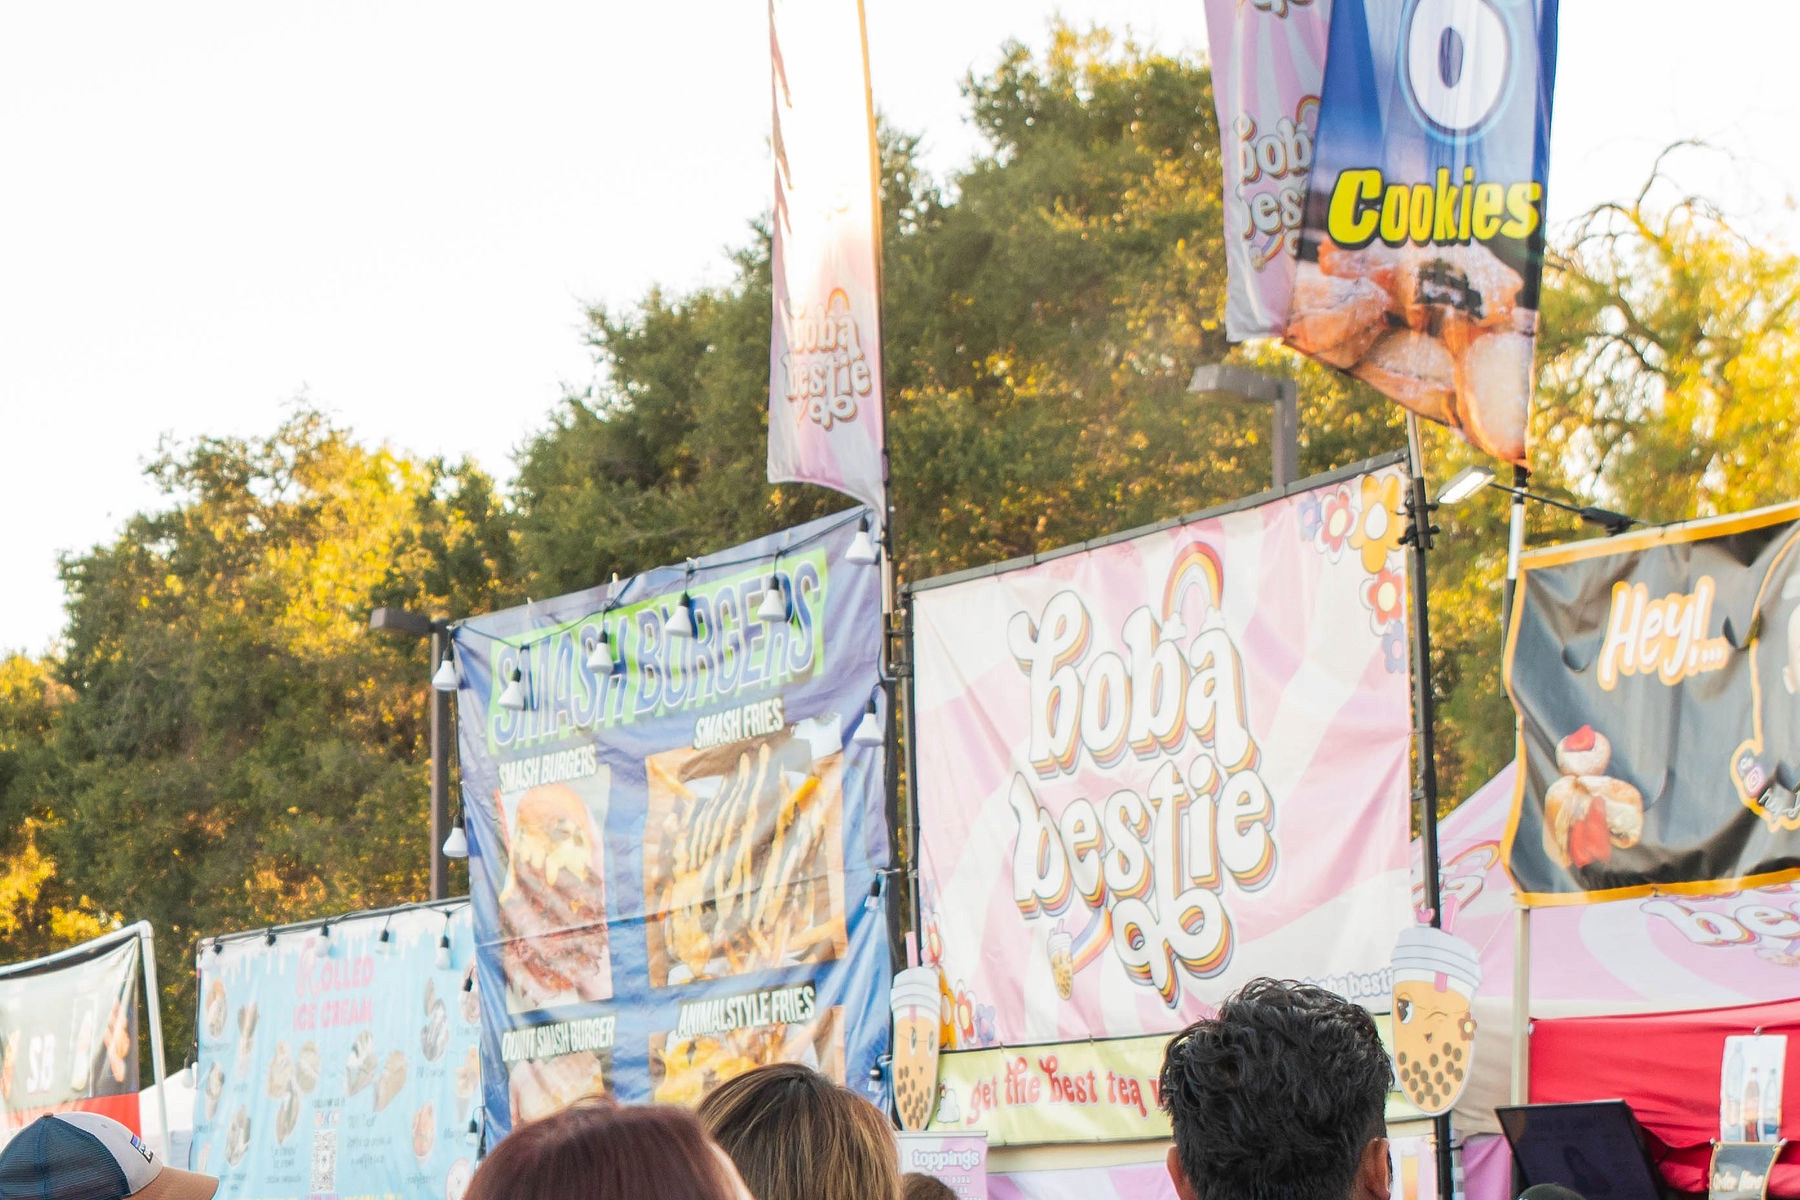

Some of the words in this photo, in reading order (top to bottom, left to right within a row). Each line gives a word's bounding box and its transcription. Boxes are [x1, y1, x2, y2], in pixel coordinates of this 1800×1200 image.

[1328, 166, 1542, 246] Cookies
[493, 614, 629, 746] SMASH
[633, 560, 822, 716] BURGERS
[1007, 590, 1260, 780] boba
[694, 710, 741, 749] SMASH
[743, 698, 785, 738] FRIES
[499, 754, 540, 793] SMASH
[541, 746, 598, 784] BURGERS
[1008, 754, 1278, 975] bestie
[297, 938, 374, 998] ROLLED
[293, 1003, 316, 1031] ICE
[321, 996, 372, 1028] CREAM
[771, 984, 816, 1023] FRIES
[536, 1022, 569, 1057] SMASH
[570, 1015, 616, 1053] BURGER
[966, 1074, 998, 1125] get
[1004, 1056, 1041, 1105] the
[1038, 1054, 1098, 1104] best
[1106, 1070, 1148, 1118] tea
[913, 1149, 979, 1171] toppings
